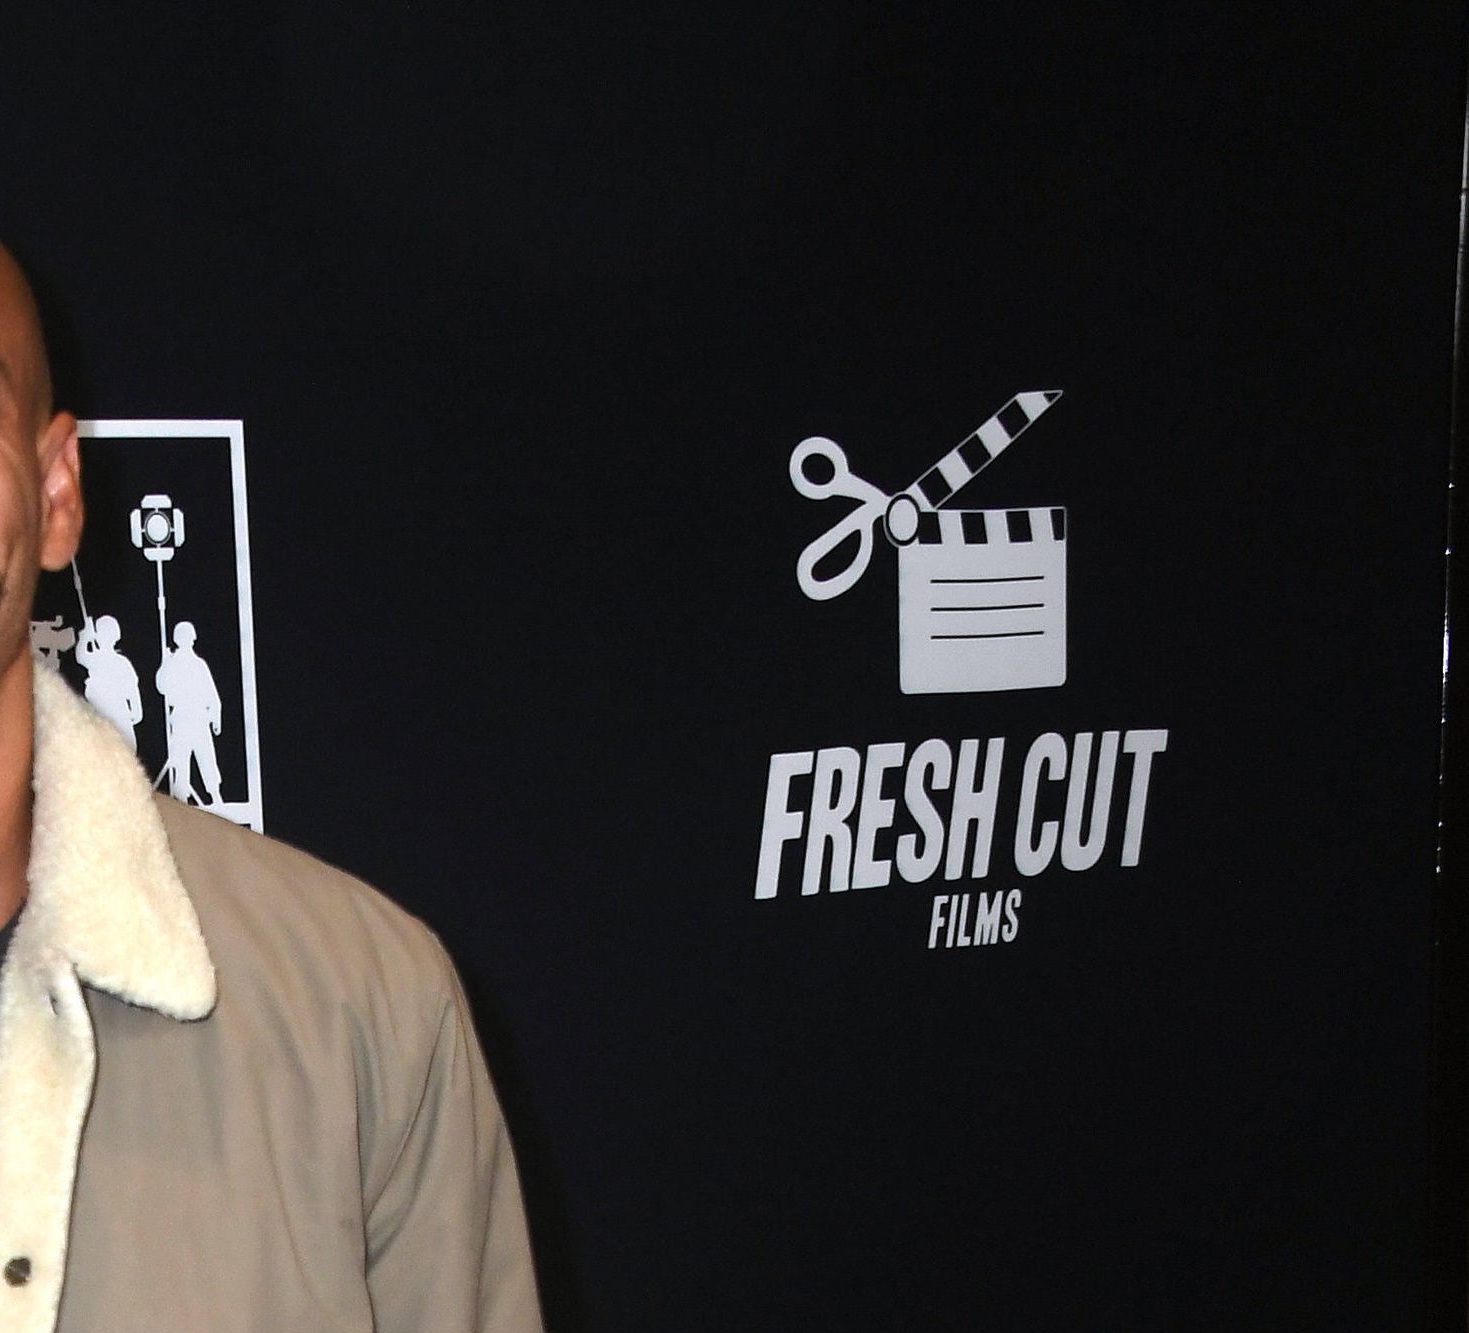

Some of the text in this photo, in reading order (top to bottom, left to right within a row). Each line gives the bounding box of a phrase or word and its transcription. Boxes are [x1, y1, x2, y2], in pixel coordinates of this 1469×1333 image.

[755, 729, 1168, 899] FRESH CUT
[929, 889, 1021, 948] FILMS
